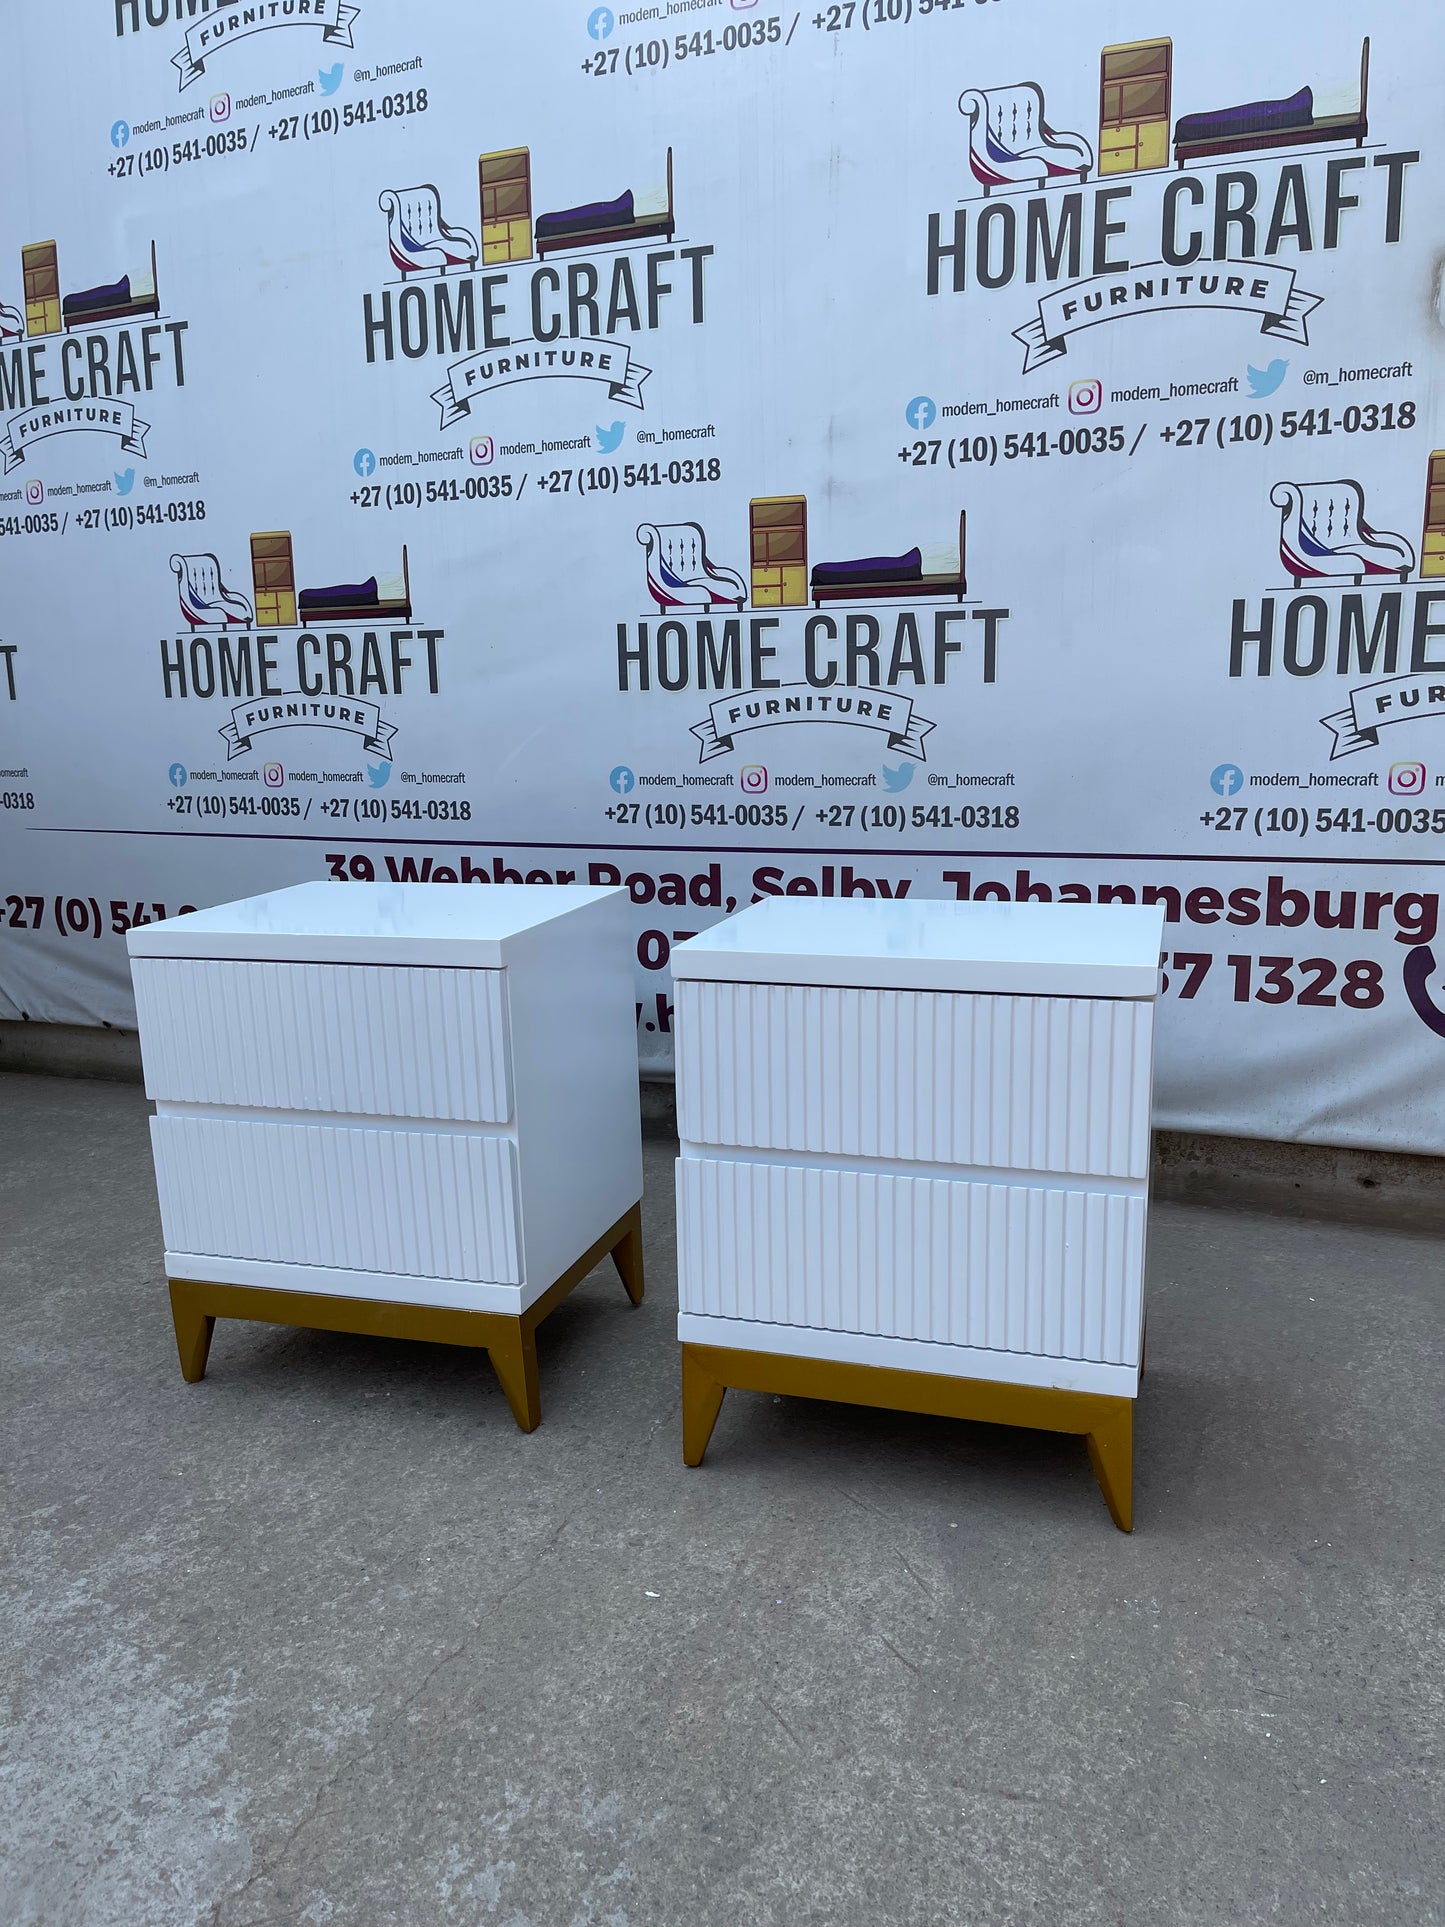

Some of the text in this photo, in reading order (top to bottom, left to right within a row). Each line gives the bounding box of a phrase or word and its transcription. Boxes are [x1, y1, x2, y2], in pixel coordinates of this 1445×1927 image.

[199, 0, 325, 46] FURNITURE
[581, 48, 619, 76] +27
[625, 38, 670, 75] (10)
[674, 17, 781, 60] 541-0035
[812, 3, 856, 31] +27
[353, 56, 423, 82] @m_homecraft
[107, 155, 134, 178] +27
[138, 147, 169, 177] (10)
[172, 129, 247, 165] 541-0035
[268, 117, 299, 141] +27
[303, 108, 339, 140] (10)
[343, 88, 428, 127] 541-0318
[926, 151, 1420, 296] HOME CRAFT
[363, 245, 714, 363] HOME CRAFT
[1062, 275, 1269, 321] FURNITURE
[61, 320, 189, 401] CRAFT
[465, 351, 611, 386] FURNITURE
[1303, 362, 1413, 386] @m_homecraft
[19, 408, 122, 437] FURNITURE
[637, 425, 715, 445] @m_homecraft
[897, 440, 941, 467] +27
[947, 436, 997, 469] (10)
[1003, 425, 1124, 460] 541-0035
[1159, 419, 1210, 447] +27
[1216, 413, 1273, 449] (10)
[1279, 402, 1416, 439] 541-0318
[350, 486, 381, 508] +27
[386, 482, 421, 509] (10)
[426, 474, 512, 503] 541-0035
[537, 470, 573, 493] +27
[578, 466, 618, 495] (10)
[623, 458, 721, 488] 541-0318
[75, 509, 101, 529] +27
[104, 506, 133, 531] (10)
[136, 500, 206, 525] 541-0318
[617, 609, 1009, 691] HOME CRAFT
[1229, 591, 1445, 677] HOME
[160, 629, 445, 698] HOME CRAFT
[246, 703, 365, 726] FURNITURE
[729, 697, 892, 723] FURNITURE
[401, 771, 466, 785] @m_homecraft
[927, 772, 1015, 788] @m_homecraft
[167, 796, 193, 814] +27
[197, 795, 227, 819] (10)
[229, 796, 300, 817] 541-0035
[320, 799, 352, 819] +27
[354, 798, 387, 822] (10)
[391, 799, 471, 821] 541-0318
[605, 804, 640, 824] +27
[645, 803, 686, 829] (10)
[691, 804, 788, 826] 541-0035
[815, 805, 856, 827] +27
[861, 804, 906, 831] (10)
[911, 805, 1019, 828] 541-0318
[1200, 807, 1248, 831] +27
[1254, 807, 1309, 837] (10)
[325, 853, 375, 882] 39
[55, 896, 101, 938] (0)
[1227, 954, 1384, 1009] 1328
